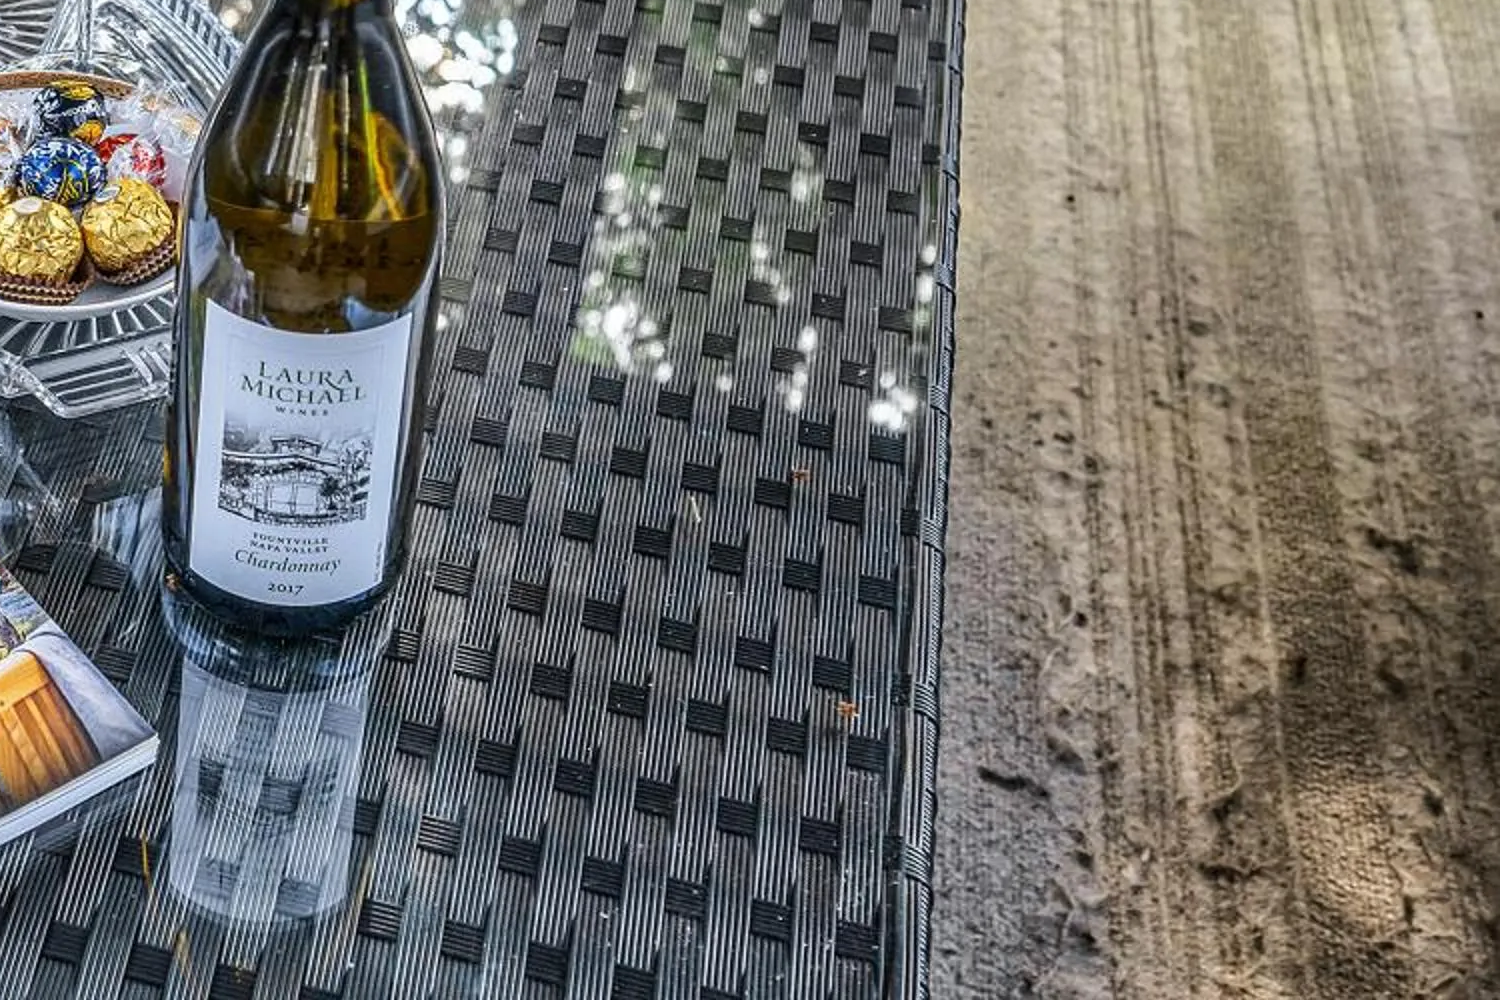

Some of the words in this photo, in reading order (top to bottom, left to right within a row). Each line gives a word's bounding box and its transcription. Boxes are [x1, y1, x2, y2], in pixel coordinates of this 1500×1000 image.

[241, 374, 367, 405] MICHAEL
[259, 361, 353, 391] LAURA
[250, 541, 281, 553] NAPA
[285, 546, 329, 554] VALLEY
[235, 549, 341, 576] Chardonnay
[267, 582, 305, 596] 2017
